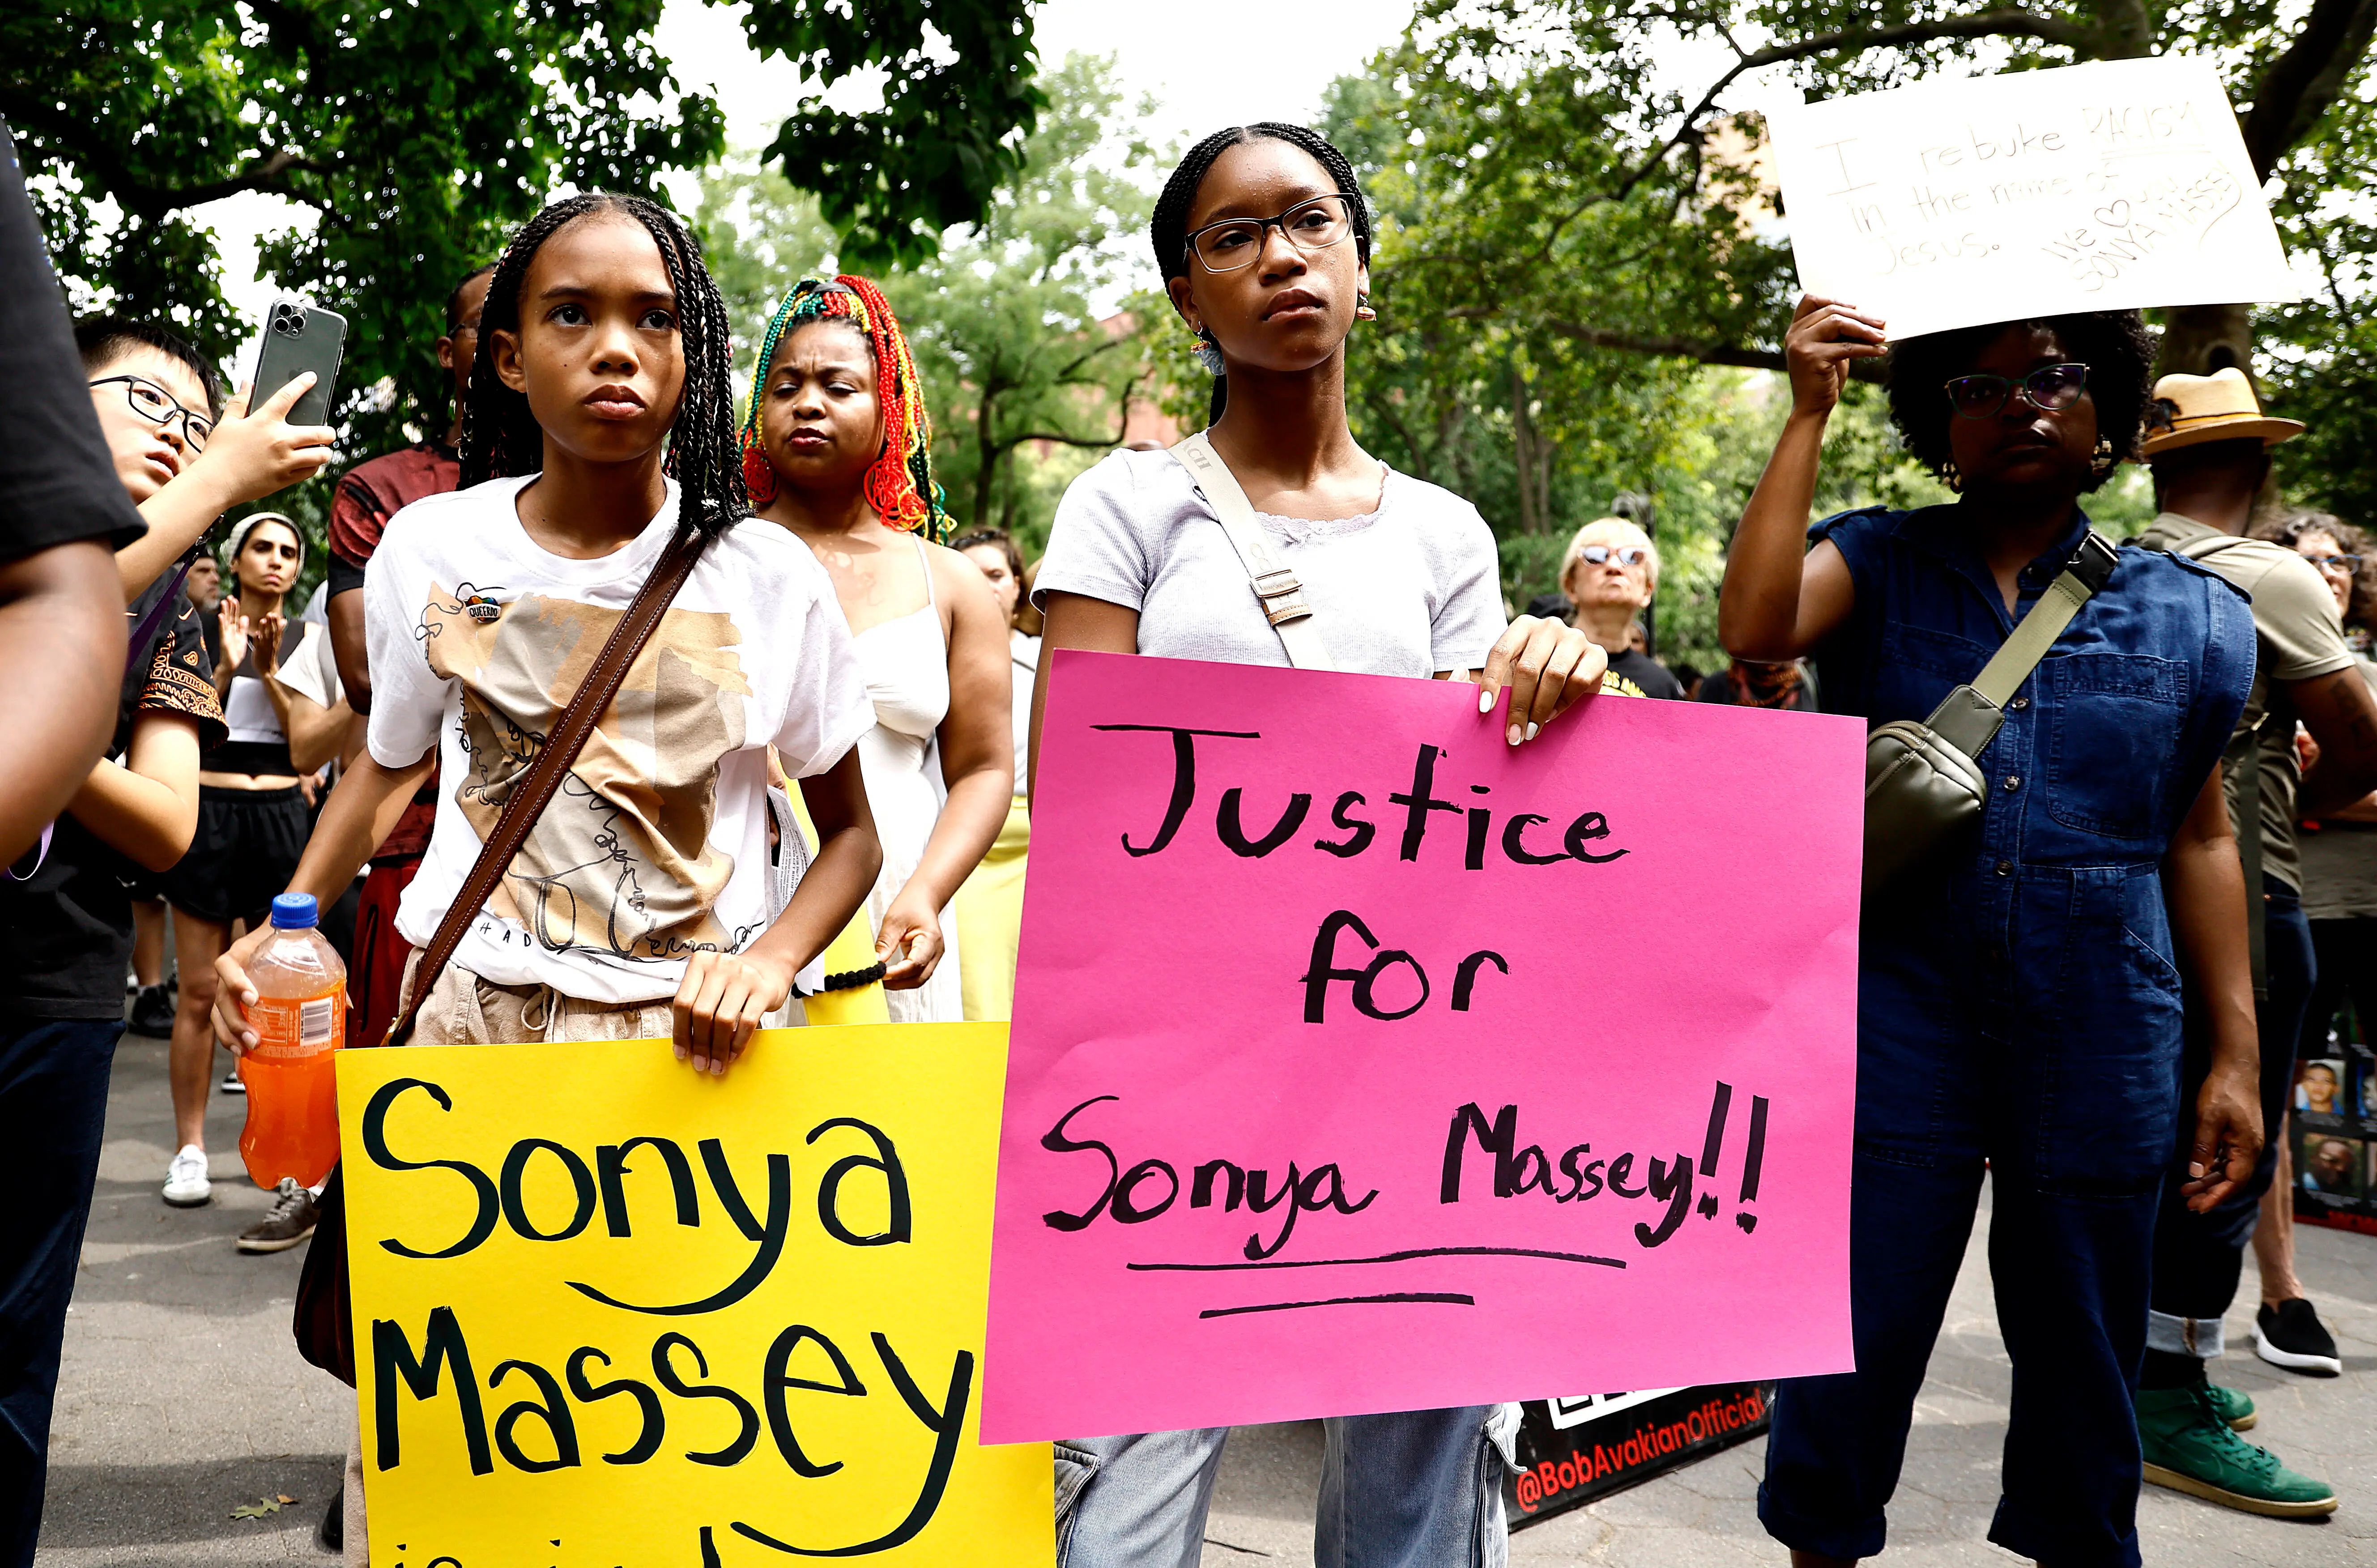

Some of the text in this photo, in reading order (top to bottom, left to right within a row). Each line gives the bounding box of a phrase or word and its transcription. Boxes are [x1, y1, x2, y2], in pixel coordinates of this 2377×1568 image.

[1814, 100, 2205, 196] I rebuke RACISM
[1847, 162, 2121, 233] in the name of
[1868, 229, 2000, 275] Jesus.
[2069, 159, 2242, 292] SONYA MASSEY
[469, 606, 497, 617] QUEERDO
[1089, 724, 1631, 871] Justice
[1299, 910, 1509, 1024] for
[362, 1077, 912, 1316] Sonya
[1041, 1080, 1770, 1261] Sonya Massey!!
[372, 1305, 975, 1557] Massey
[1517, 1388, 1764, 1513] @BobAvakianOfficial
